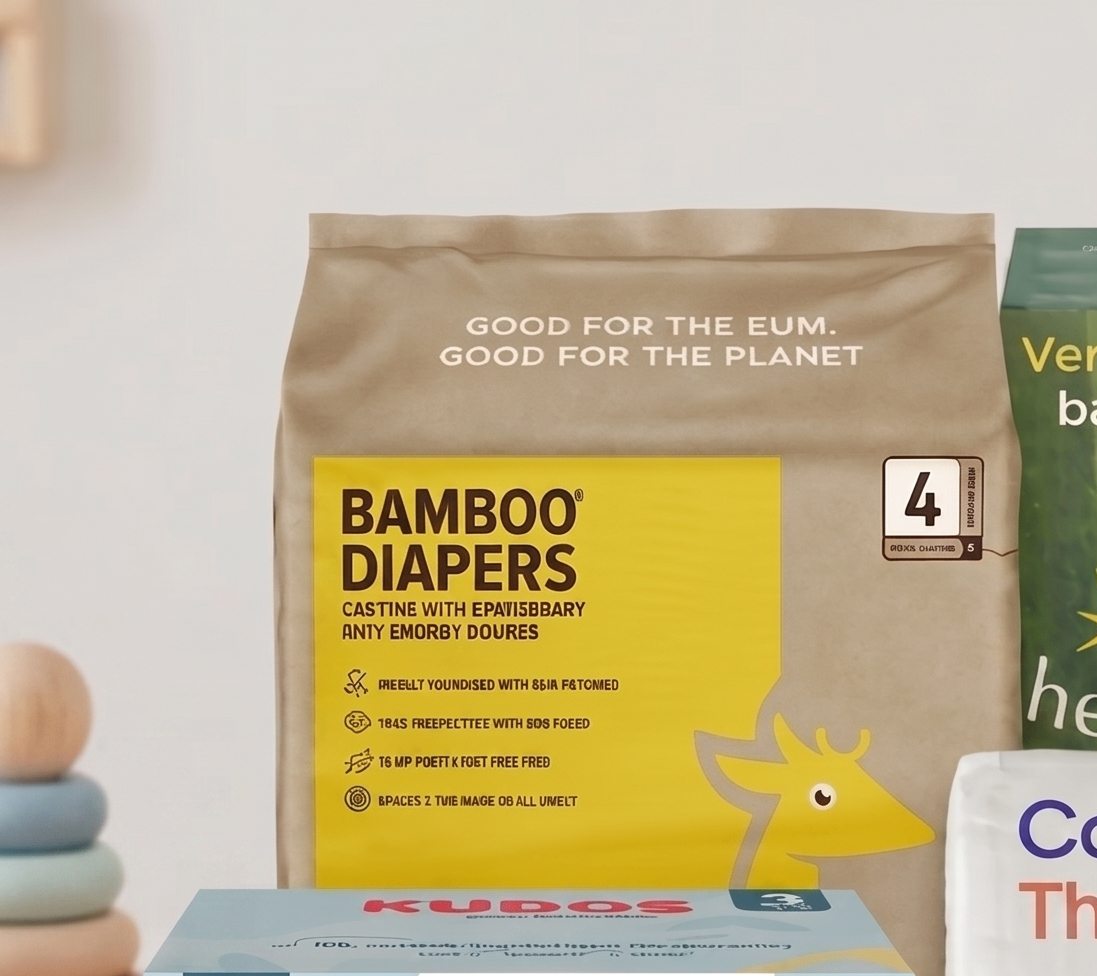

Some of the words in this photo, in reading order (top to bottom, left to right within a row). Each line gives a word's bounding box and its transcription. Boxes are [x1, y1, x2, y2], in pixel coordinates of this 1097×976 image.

[466, 316, 571, 337] GOOD
[582, 316, 654, 337] FOR
[665, 316, 735, 337] THE
[748, 316, 837, 337] EUM.
[439, 346, 545, 368] GOOD
[557, 346, 628, 368] FOR
[641, 346, 712, 368] THE
[725, 346, 864, 368] PLANET
[904, 471, 942, 527] 4
[967, 543, 976, 552] 5
[341, 543, 578, 592] DIAPERS
[342, 601, 418, 618] CASTINE
[421, 601, 467, 618] WITH
[389, 623, 463, 641] EMORBY
[466, 623, 540, 641] DOURES
[498, 679, 529, 691] WITH
[492, 718, 523, 730] WITH
[490, 756, 519, 768] FREE
[516, 795, 537, 807] ALL
[363, 900, 694, 914] KUDOS
